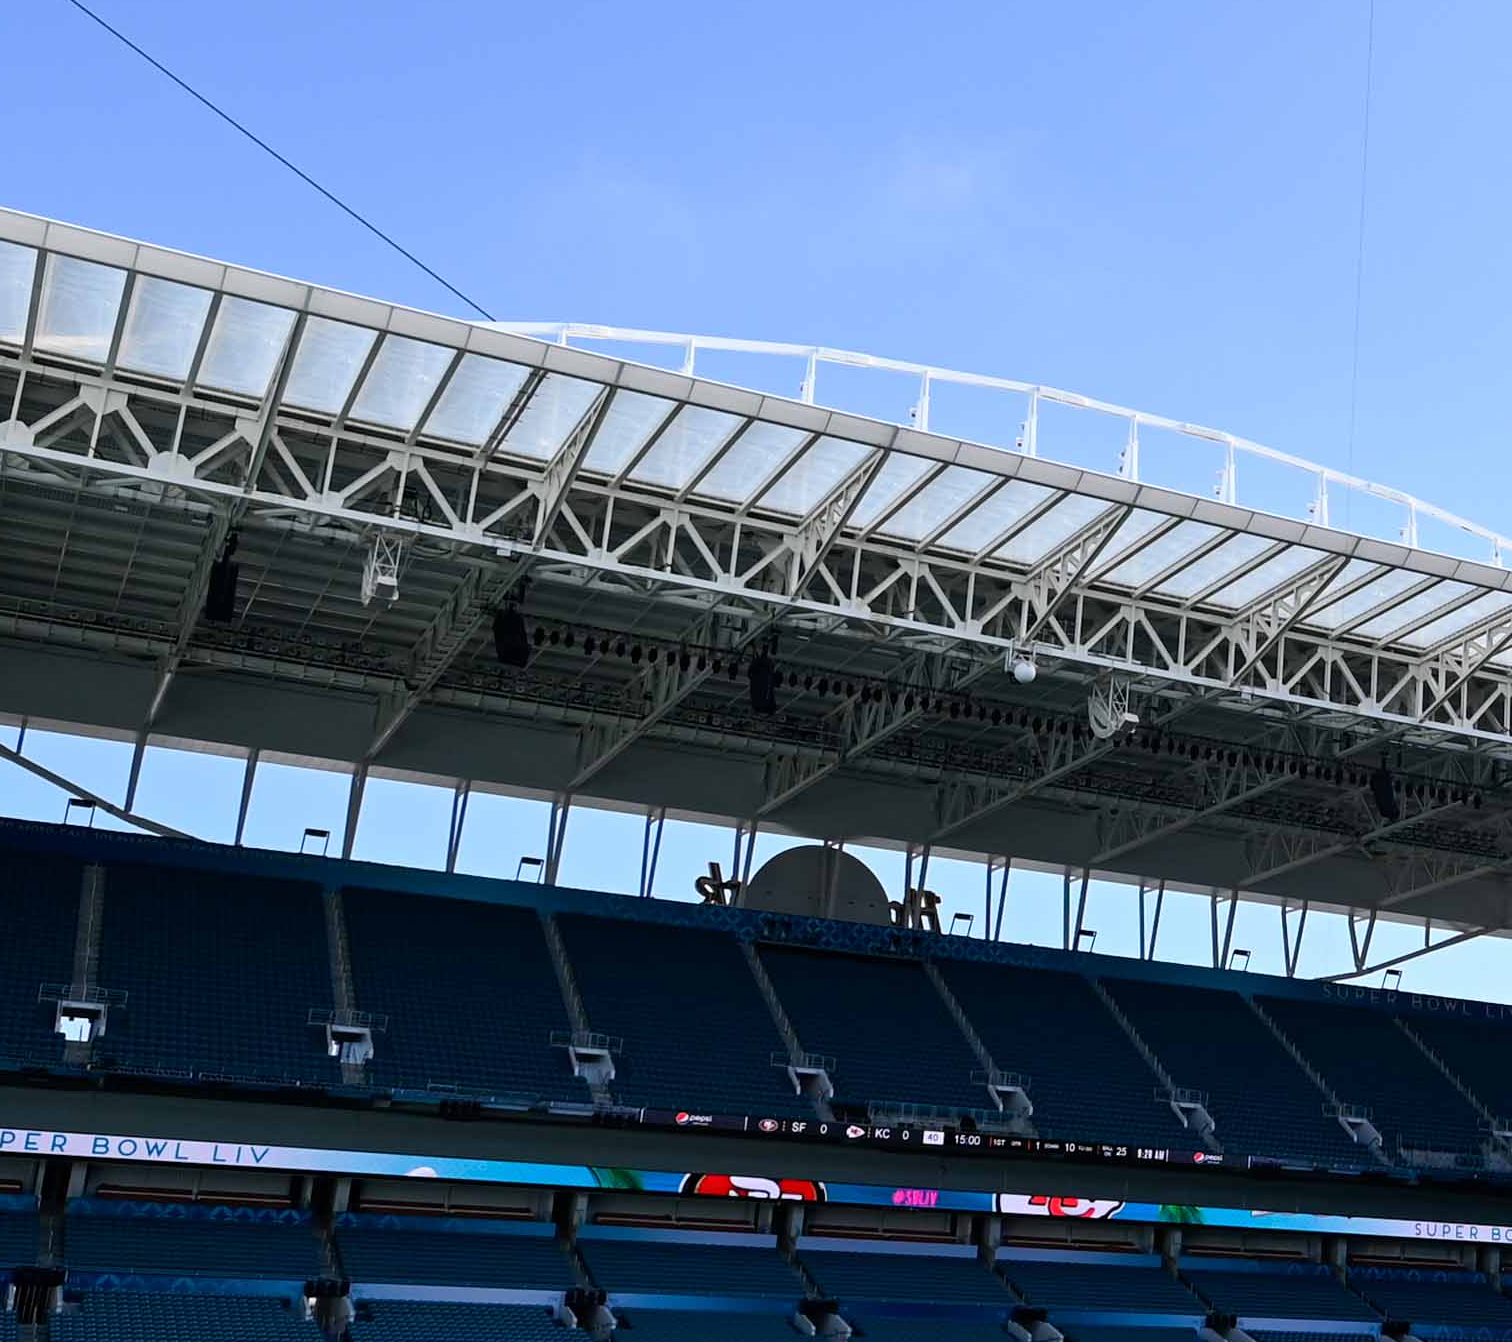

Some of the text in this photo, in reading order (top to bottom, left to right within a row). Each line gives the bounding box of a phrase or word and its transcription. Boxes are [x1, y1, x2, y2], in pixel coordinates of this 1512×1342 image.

[1322, 984, 1398, 1005] SUPER
[1411, 994, 1473, 1017] BOWL
[91, 1137, 189, 1161] BOWL
[213, 1144, 270, 1165] LIV
[792, 1122, 807, 1133] SF
[820, 1124, 827, 1134] 0
[875, 1128, 891, 1139] KC
[902, 1130, 909, 1140] 0
[954, 1134, 981, 1147] 15:00
[1065, 1143, 1076, 1153] 10
[1116, 1147, 1127, 1157] 25
[1414, 1223, 1480, 1241] SUPER
